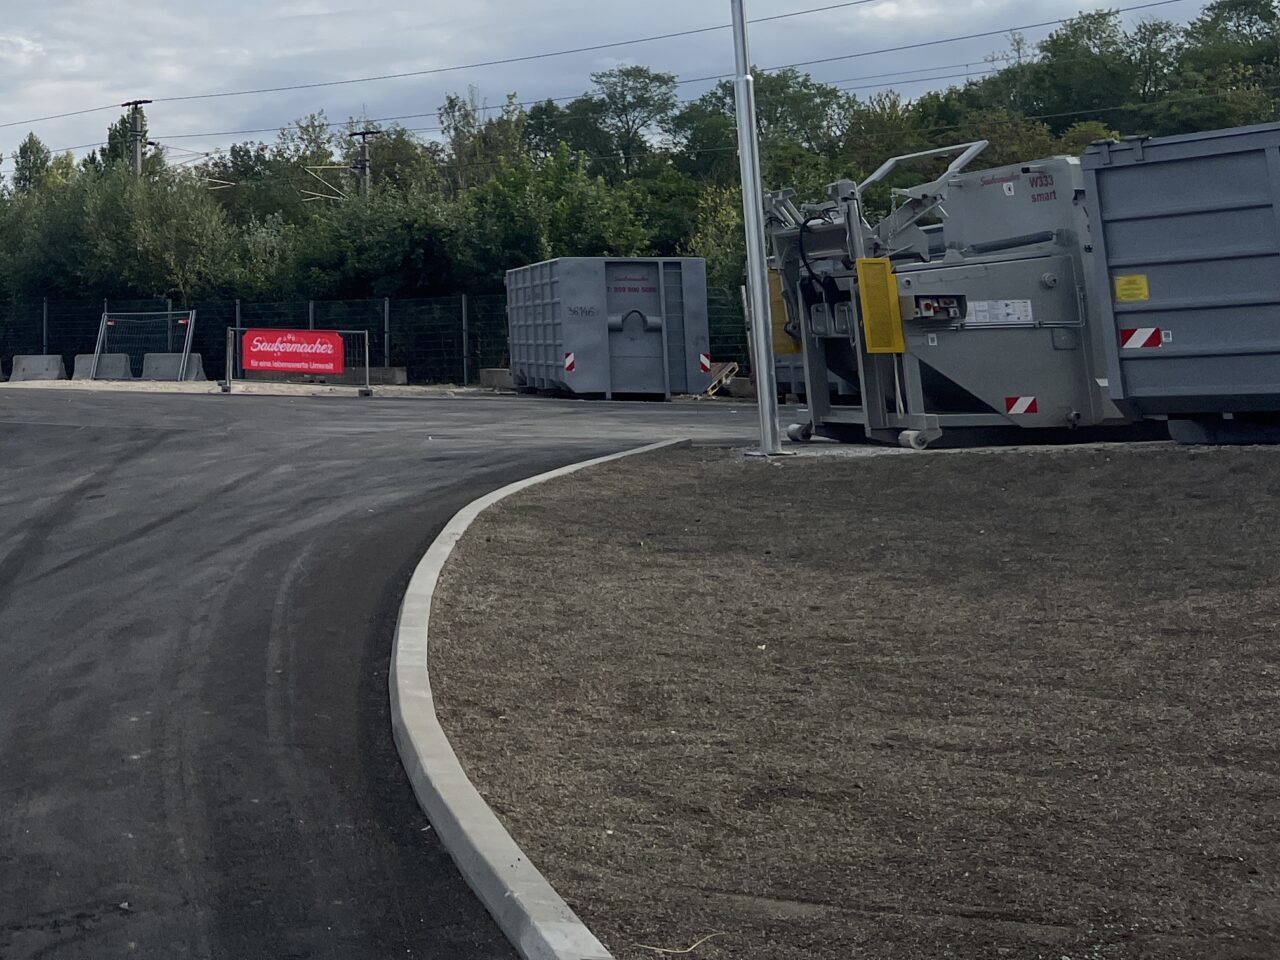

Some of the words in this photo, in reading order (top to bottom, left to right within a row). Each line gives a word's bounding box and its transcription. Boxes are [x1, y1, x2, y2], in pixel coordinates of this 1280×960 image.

[1028, 174, 1054, 189] W333
[1031, 189, 1057, 203] smart
[249, 336, 334, 354] Saubermacher
